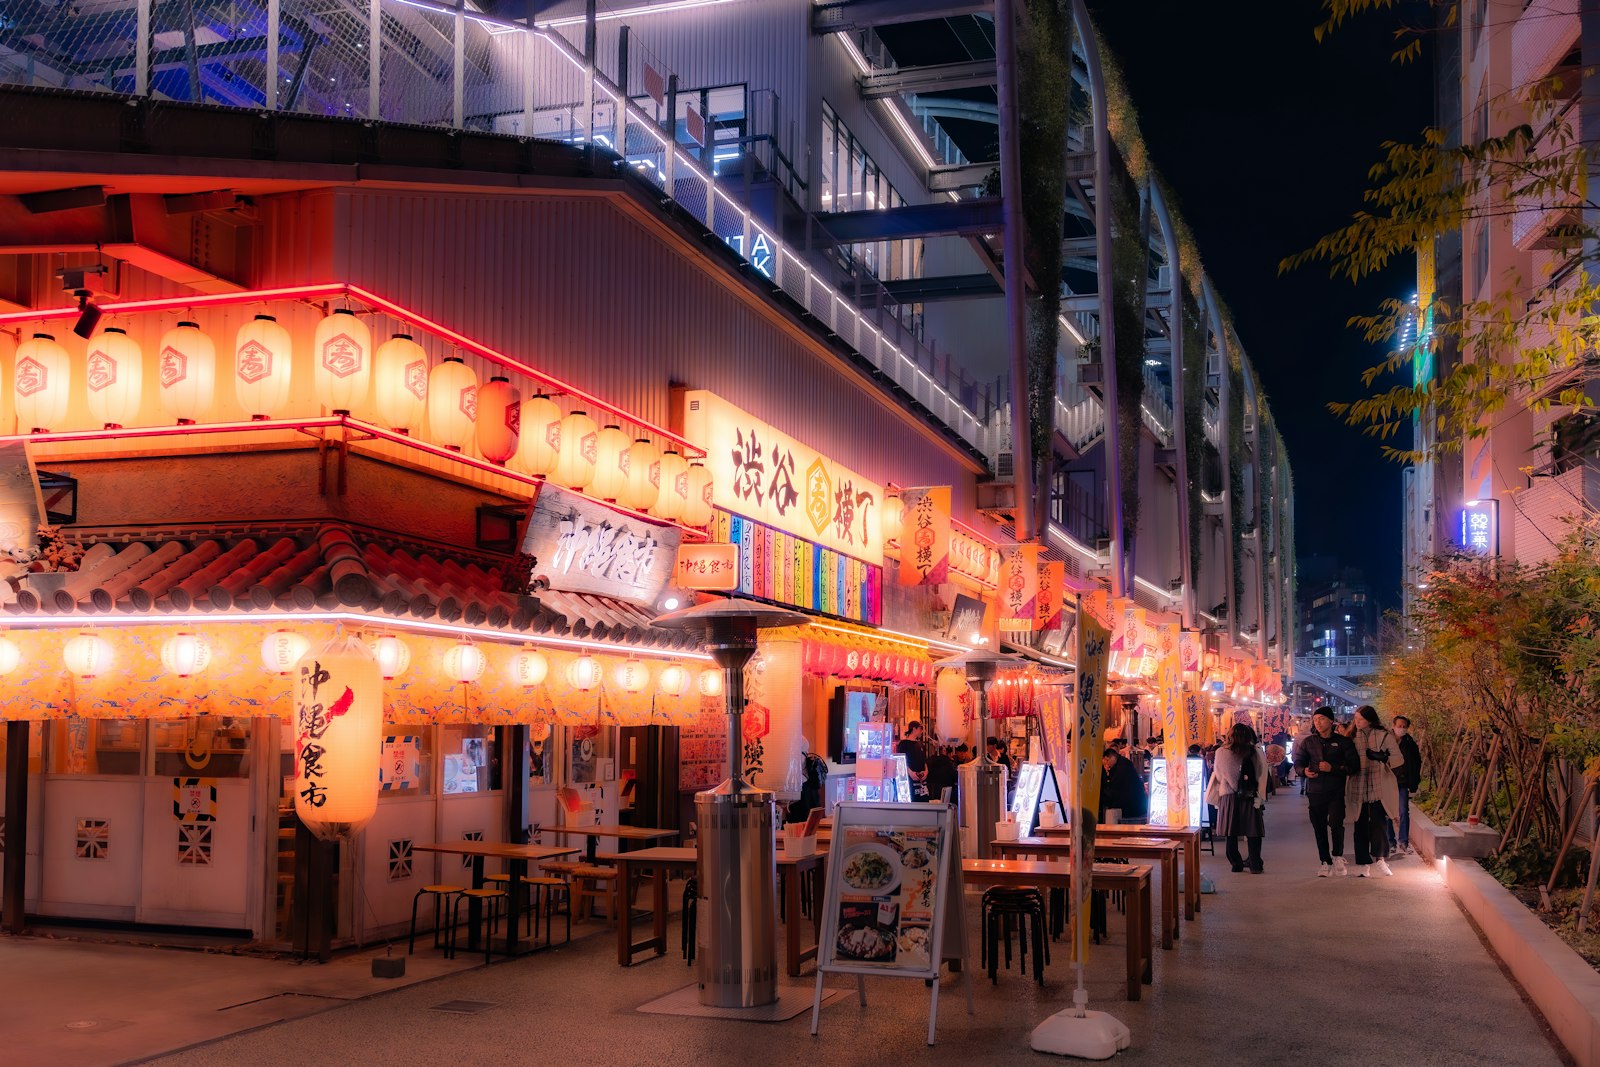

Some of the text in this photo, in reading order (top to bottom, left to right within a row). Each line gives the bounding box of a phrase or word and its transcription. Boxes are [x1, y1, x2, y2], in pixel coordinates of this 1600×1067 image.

[679, 559, 735, 574] 沖縄食市
[299, 660, 331, 812] 沖縄食市
